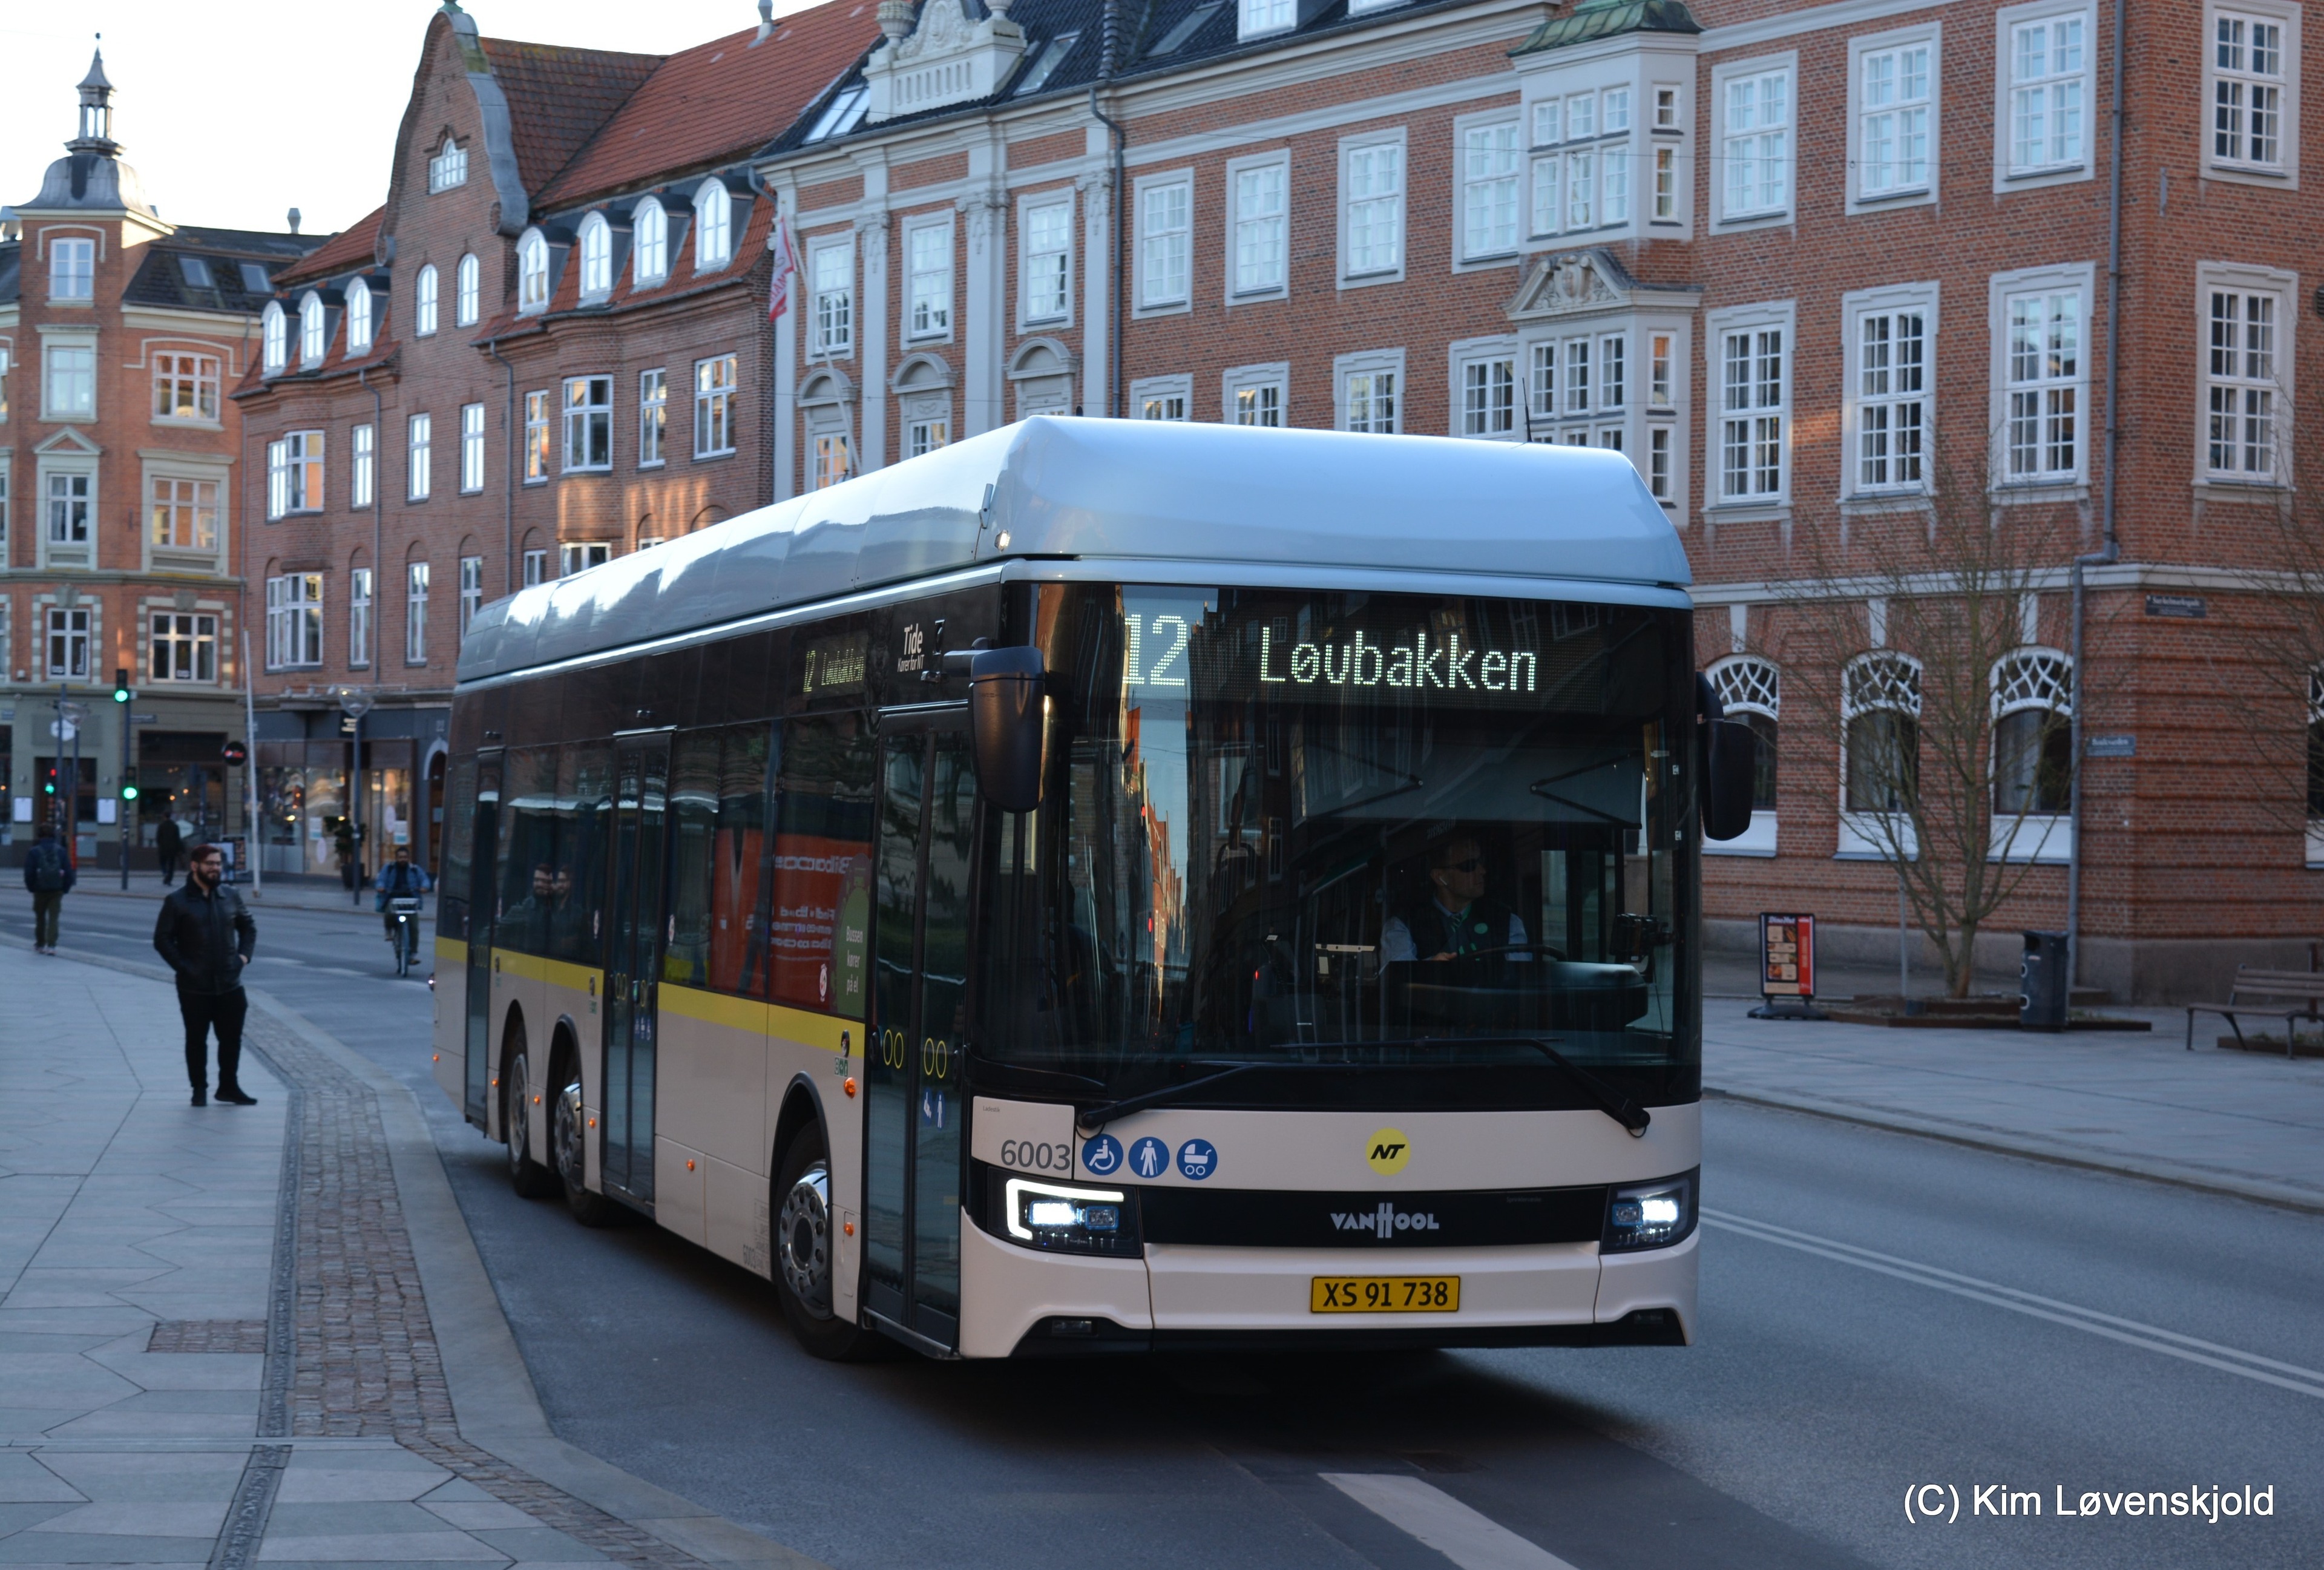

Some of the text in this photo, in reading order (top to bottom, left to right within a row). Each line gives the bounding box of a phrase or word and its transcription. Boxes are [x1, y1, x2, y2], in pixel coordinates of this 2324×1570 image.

[904, 623, 923, 655] Tide
[917, 654, 925, 670] NT
[1123, 614, 1537, 692] 12 Løubakken
[846, 926, 863, 943] Bussen
[847, 950, 861, 968] kører
[846, 974, 858, 996] på el
[1001, 1140, 1071, 1171] 6003
[1370, 1144, 1406, 1160] NT
[1323, 1281, 1449, 1307] XS 91 738
